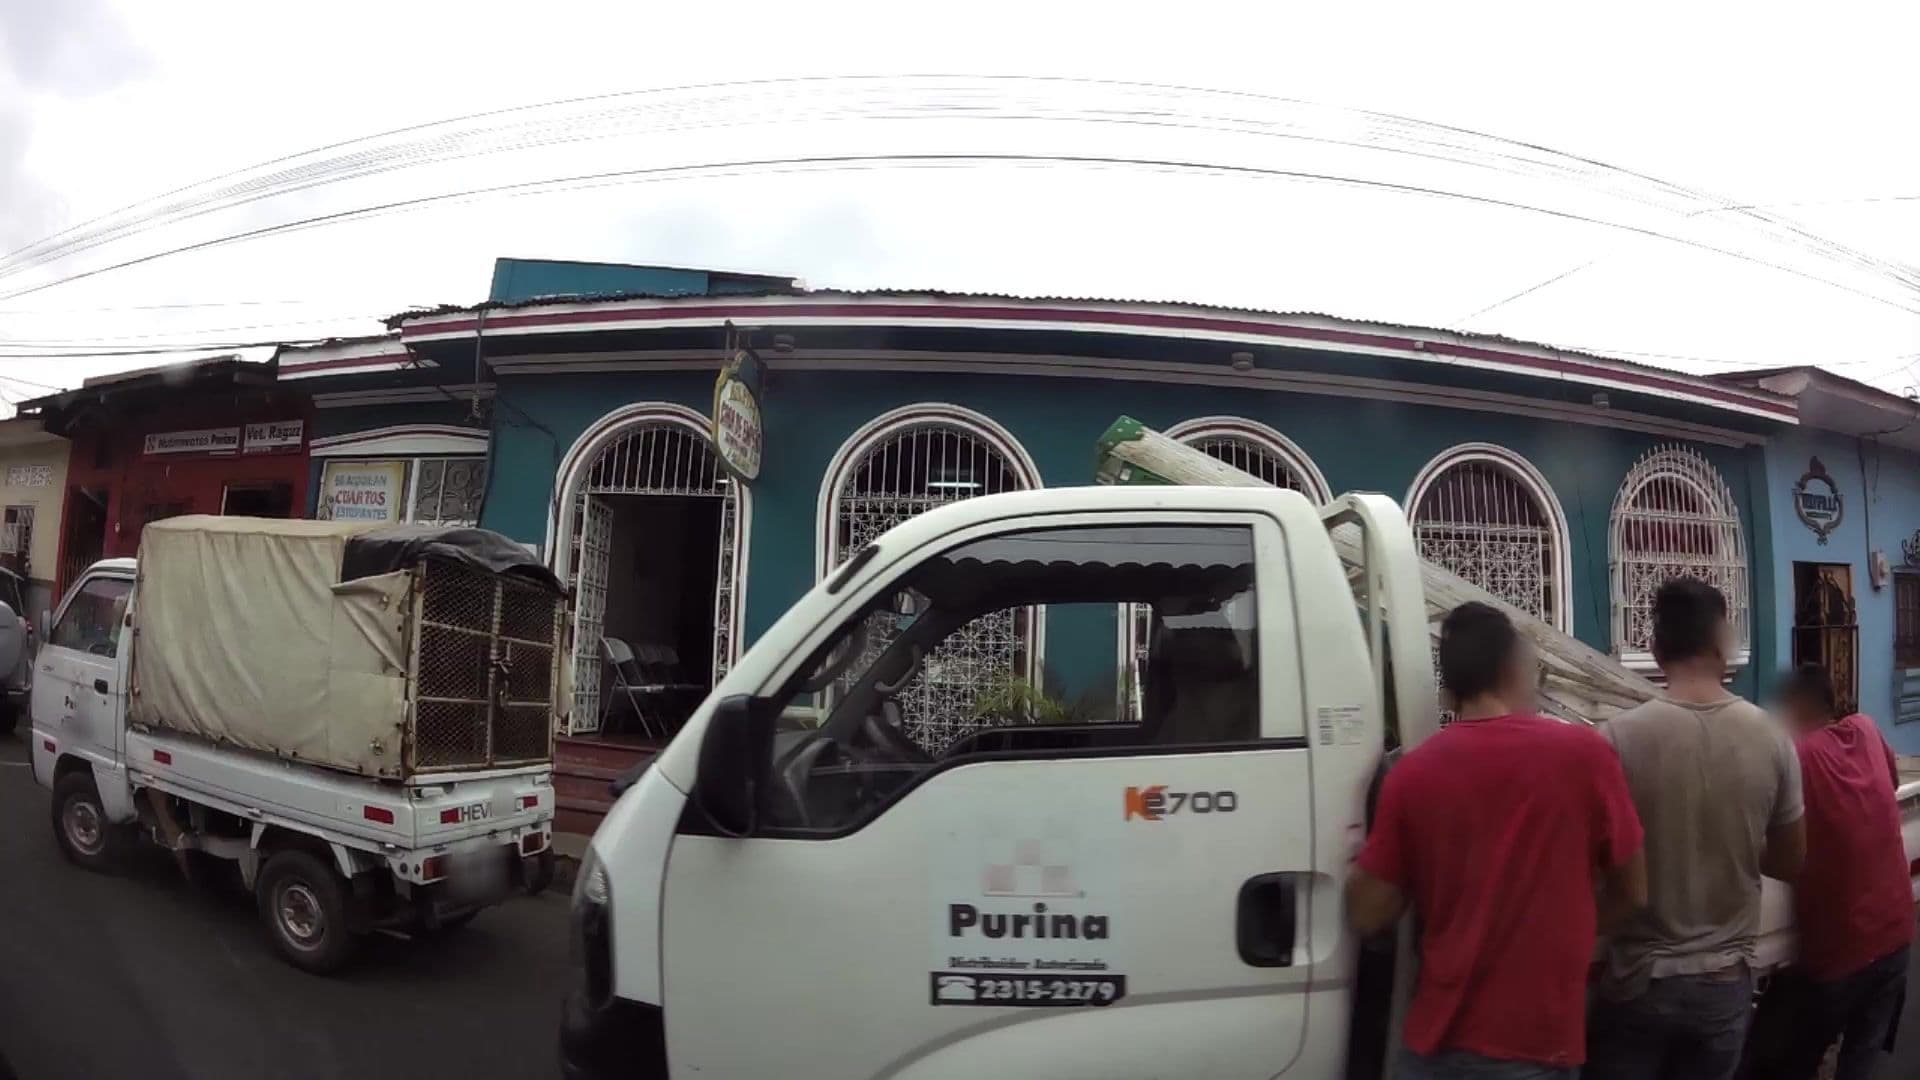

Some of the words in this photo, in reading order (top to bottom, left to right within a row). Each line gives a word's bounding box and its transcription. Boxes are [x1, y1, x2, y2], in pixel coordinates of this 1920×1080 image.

[335, 489, 387, 506] CUARTOS
[949, 902, 1109, 939] Purina
[979, 980, 1117, 1001] 2315-2279
